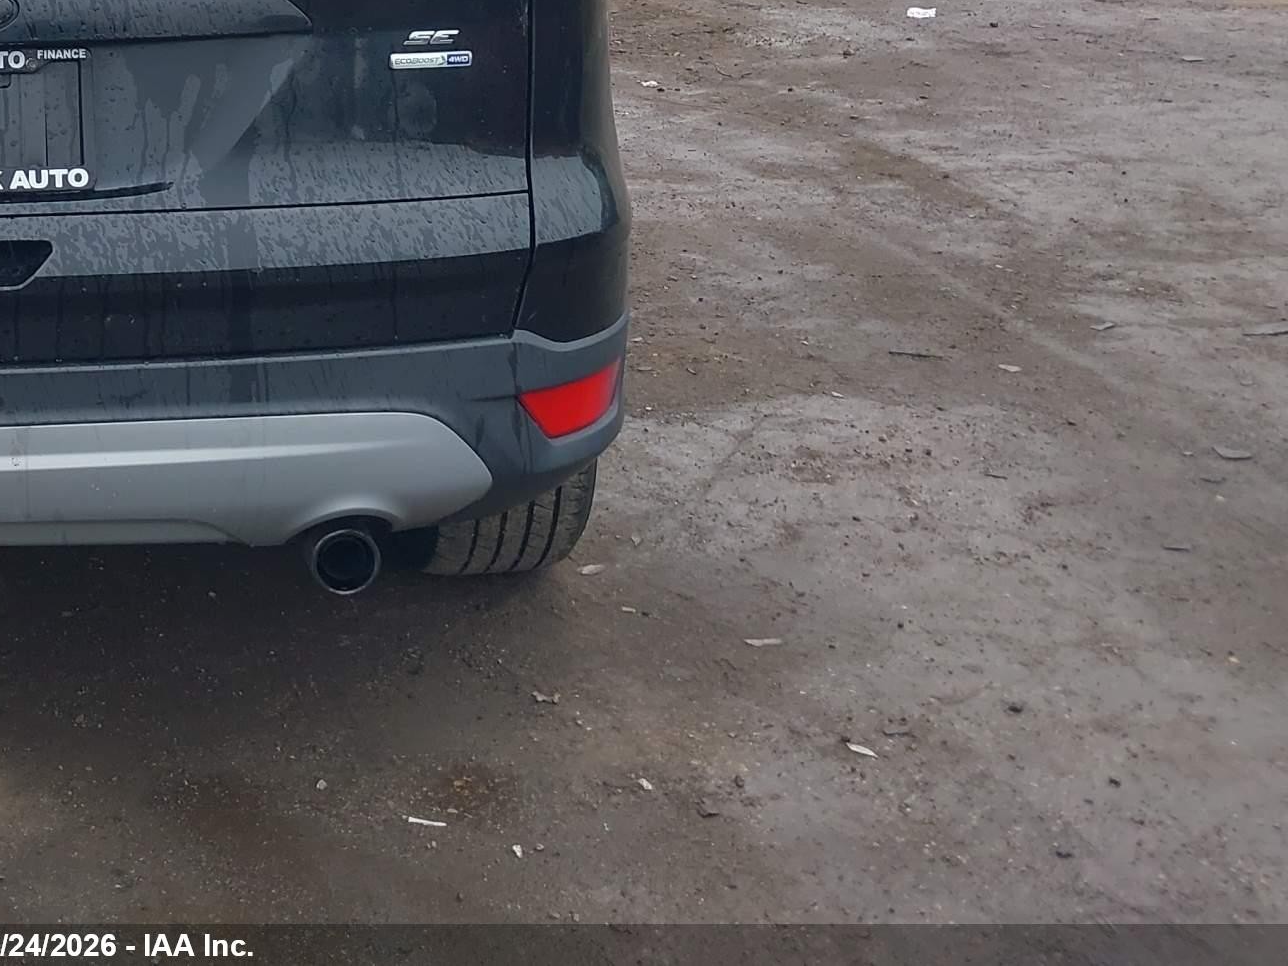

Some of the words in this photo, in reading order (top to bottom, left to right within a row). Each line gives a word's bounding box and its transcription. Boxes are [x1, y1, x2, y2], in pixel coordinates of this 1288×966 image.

[403, 29, 459, 45] SE
[36, 48, 87, 60] FINANCE
[448, 55, 469, 63] 4WD
[10, 168, 89, 189] AUTO
